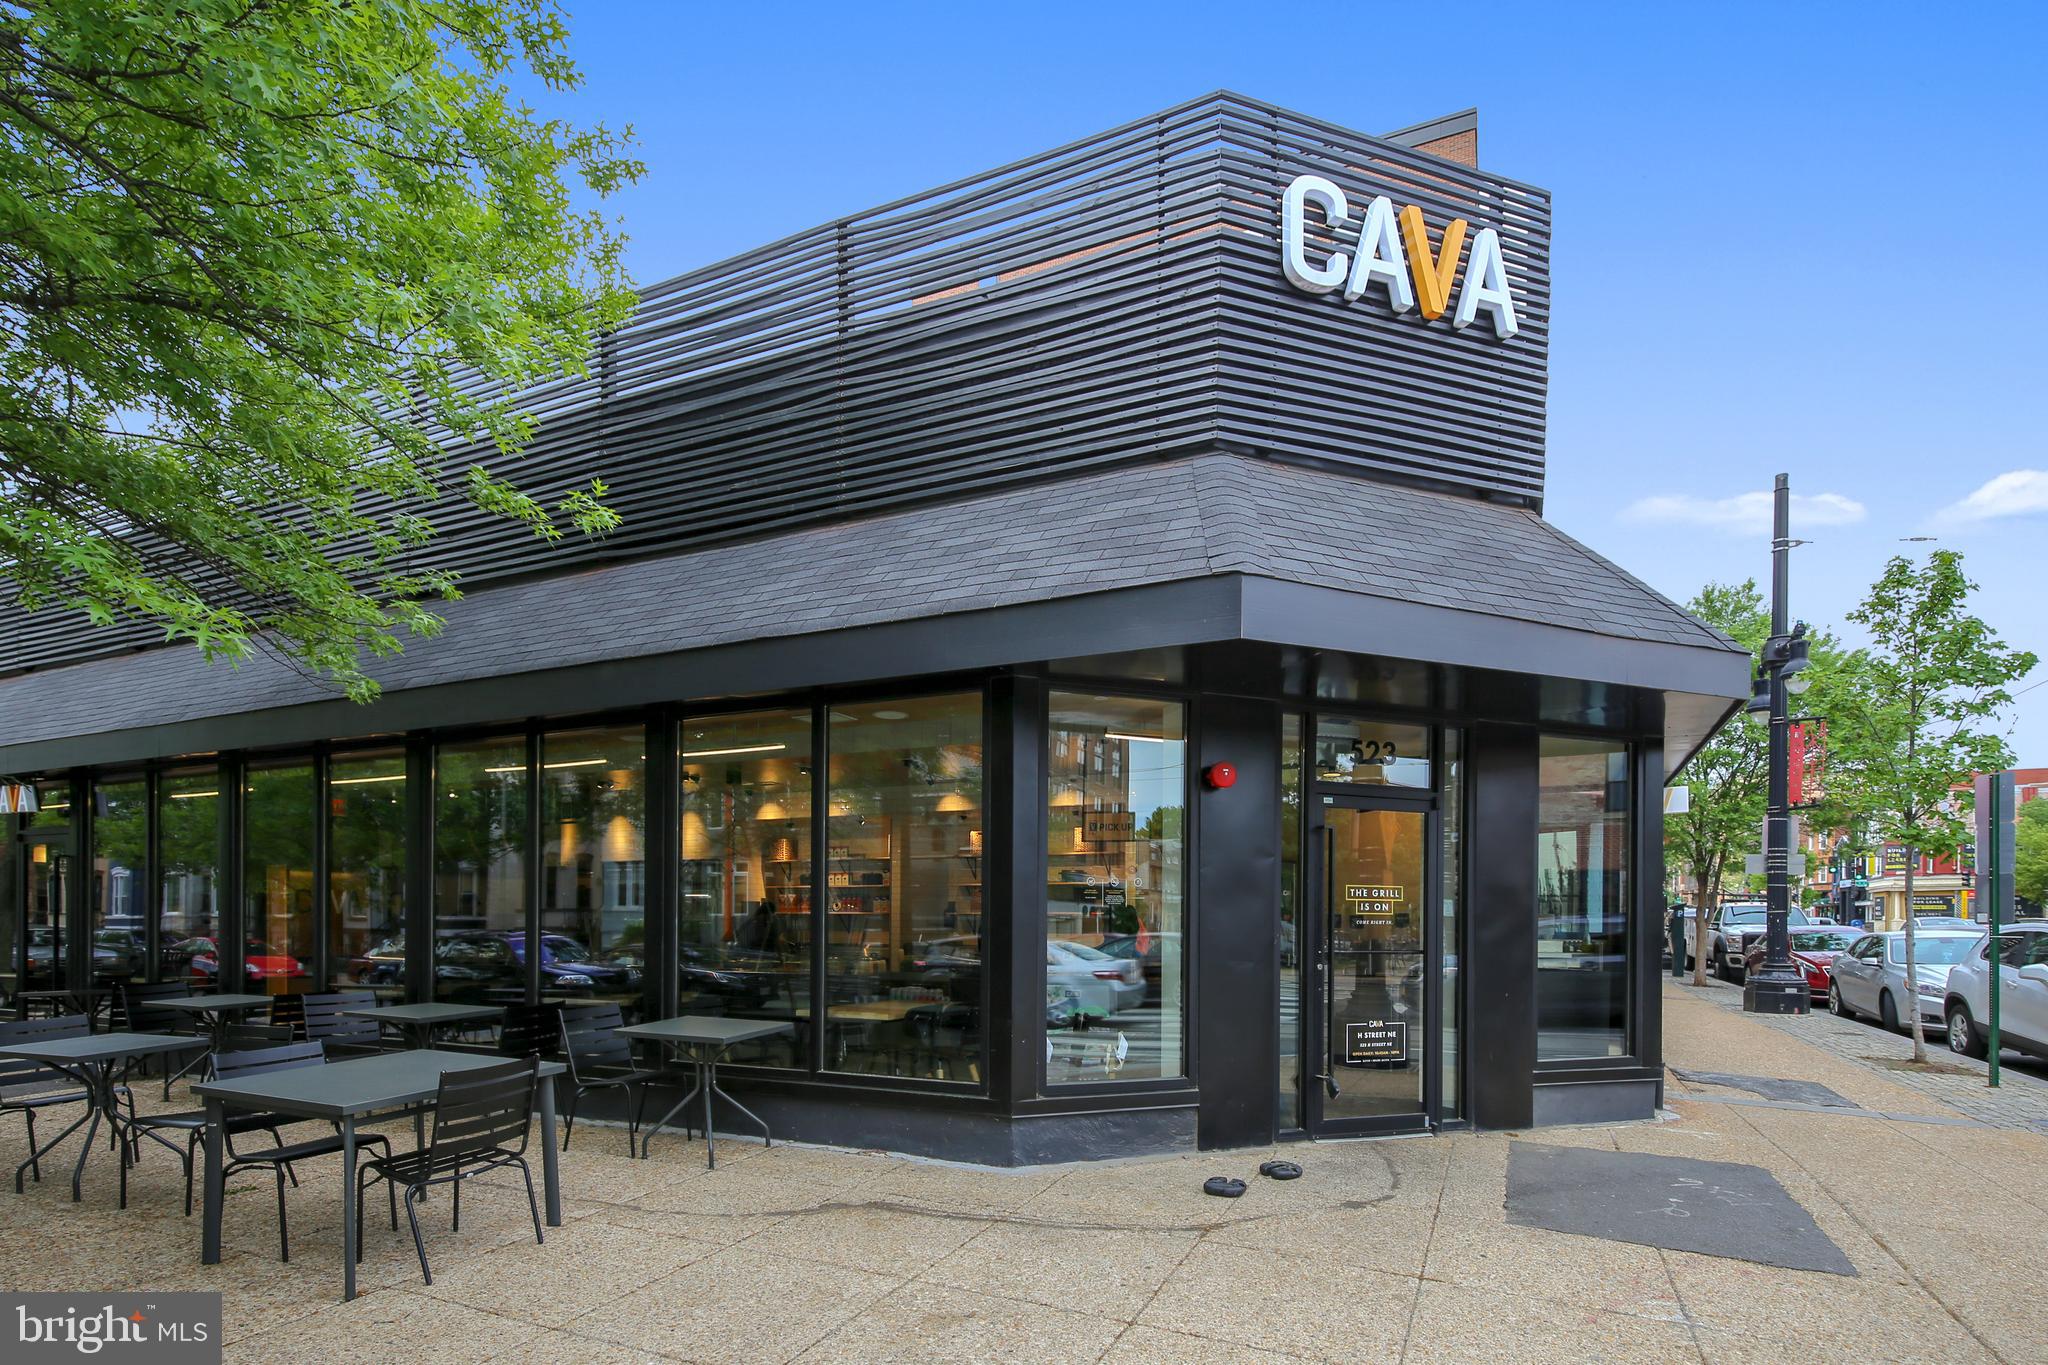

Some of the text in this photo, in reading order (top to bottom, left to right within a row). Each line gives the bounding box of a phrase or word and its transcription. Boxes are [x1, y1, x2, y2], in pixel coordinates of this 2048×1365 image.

[1282, 175, 1519, 340] CAVA
[1351, 740, 1396, 765] 523
[1099, 823, 1119, 831] PICK
[1350, 888, 1399, 898] THE GRILL
[1360, 902, 1389, 911] IS ON
[1357, 1031, 1363, 1039] H
[1364, 1031, 1386, 1039] STREET
